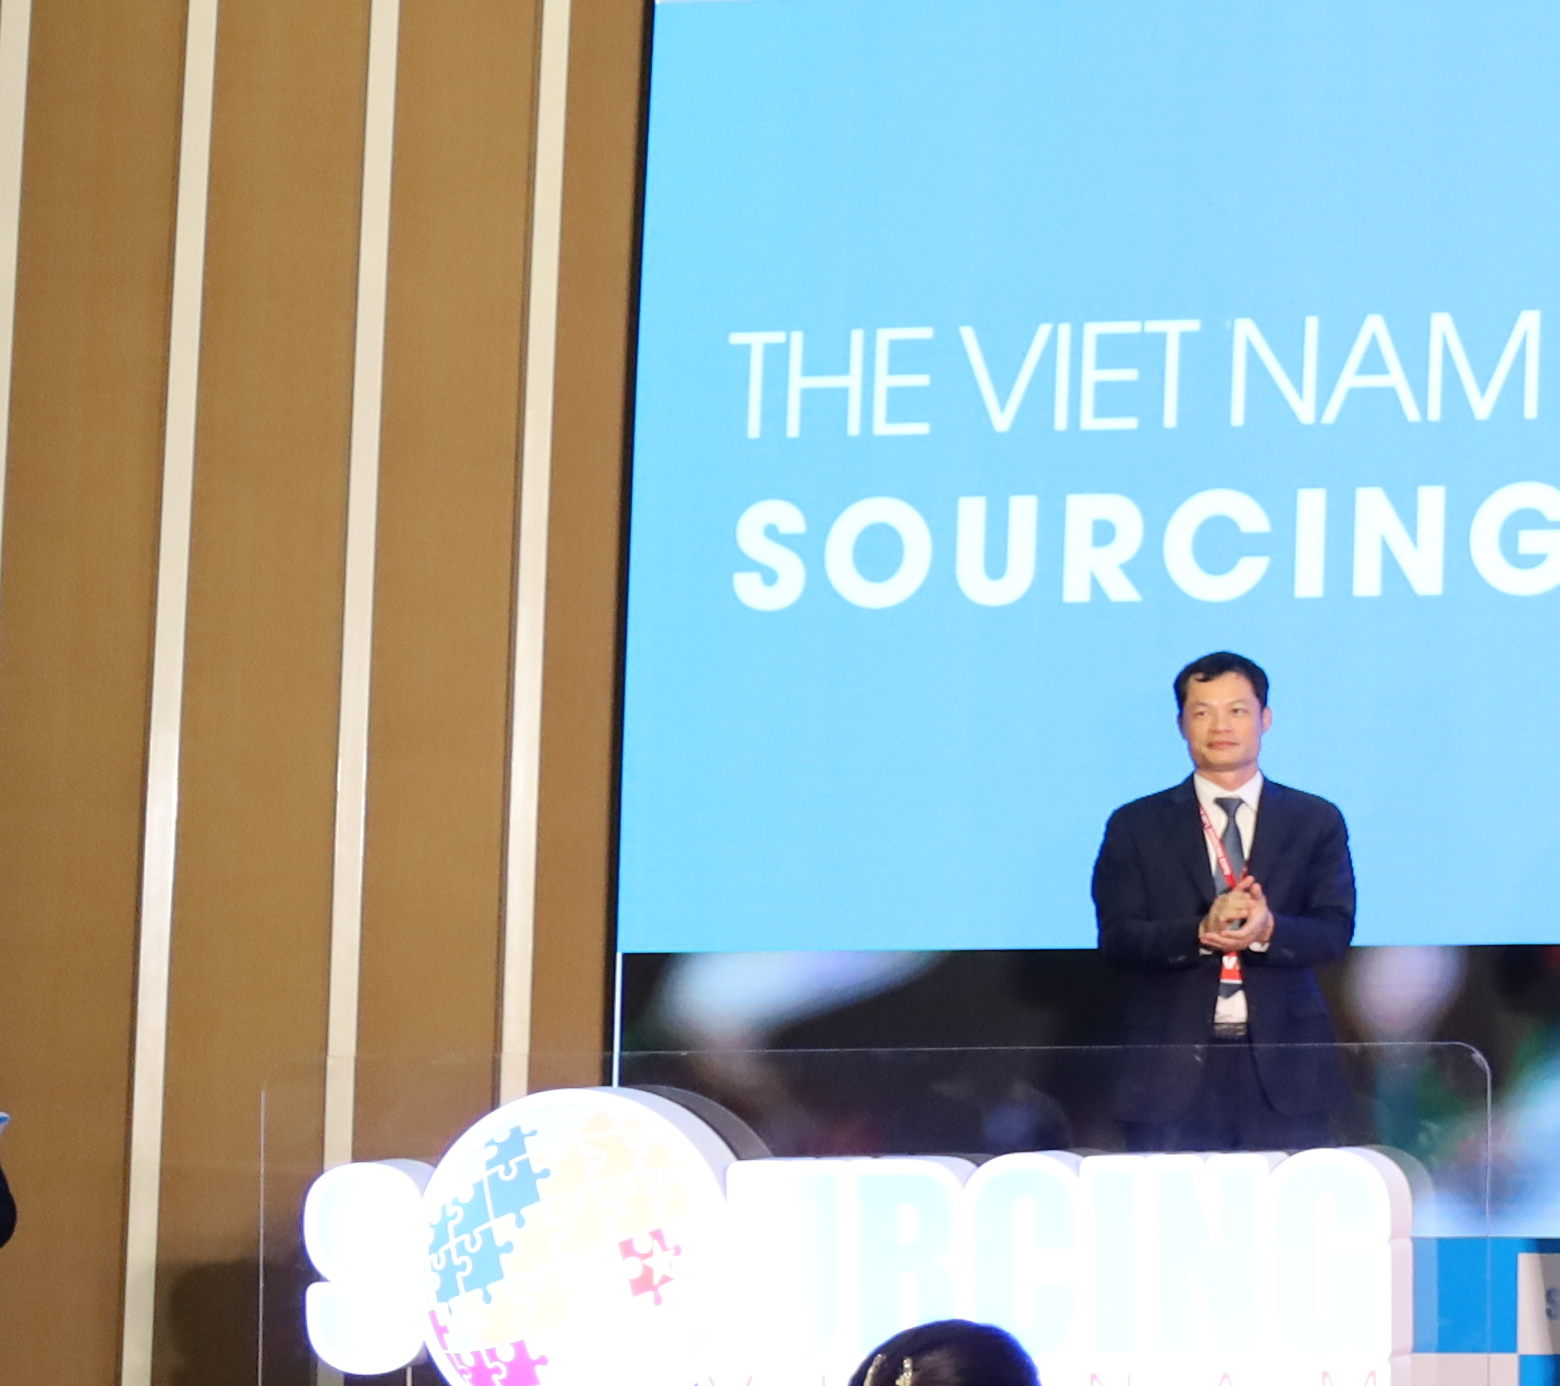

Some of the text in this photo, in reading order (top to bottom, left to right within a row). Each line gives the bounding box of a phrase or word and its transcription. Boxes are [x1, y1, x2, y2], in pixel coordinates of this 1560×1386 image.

[728, 326, 934, 439] THE
[958, 319, 1201, 433] VIET
[1229, 309, 1541, 428] NAM
